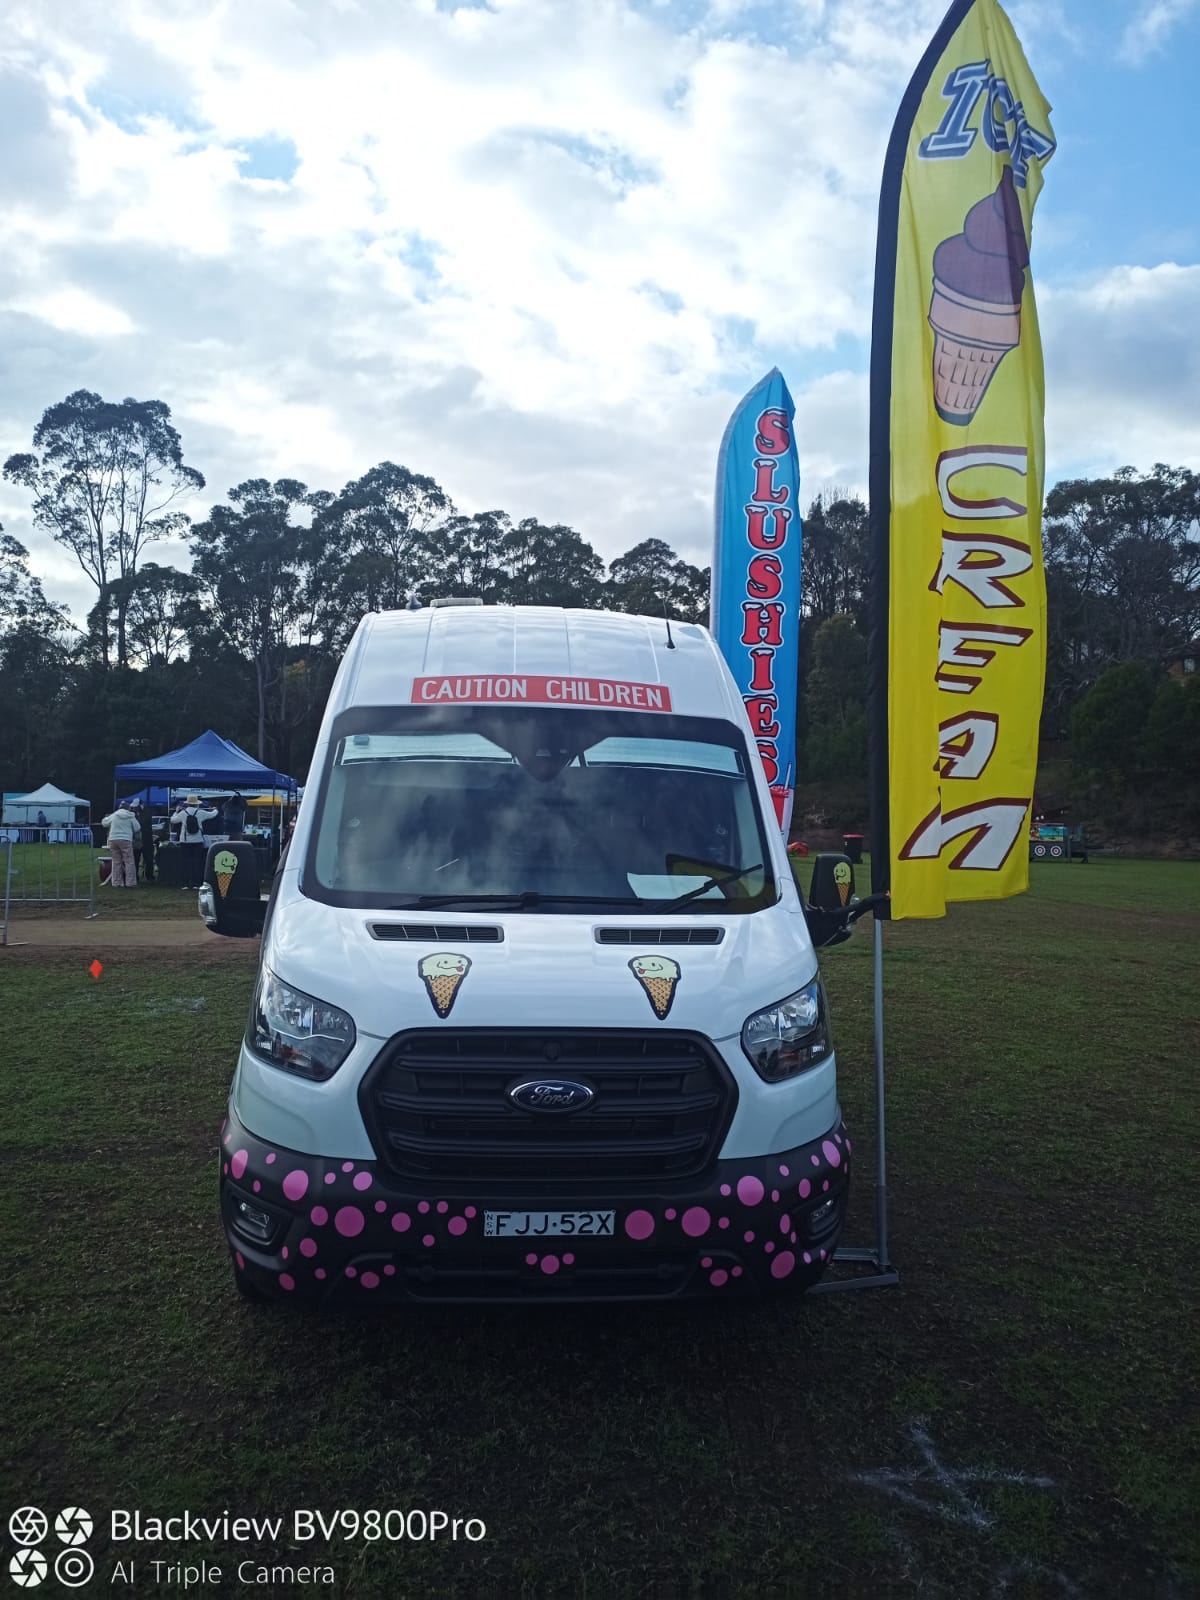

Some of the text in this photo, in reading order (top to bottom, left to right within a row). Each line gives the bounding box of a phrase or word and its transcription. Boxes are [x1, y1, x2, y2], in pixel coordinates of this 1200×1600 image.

[421, 678, 662, 708] CAUTION CHILDREN
[531, 1085, 575, 1105] Ford
